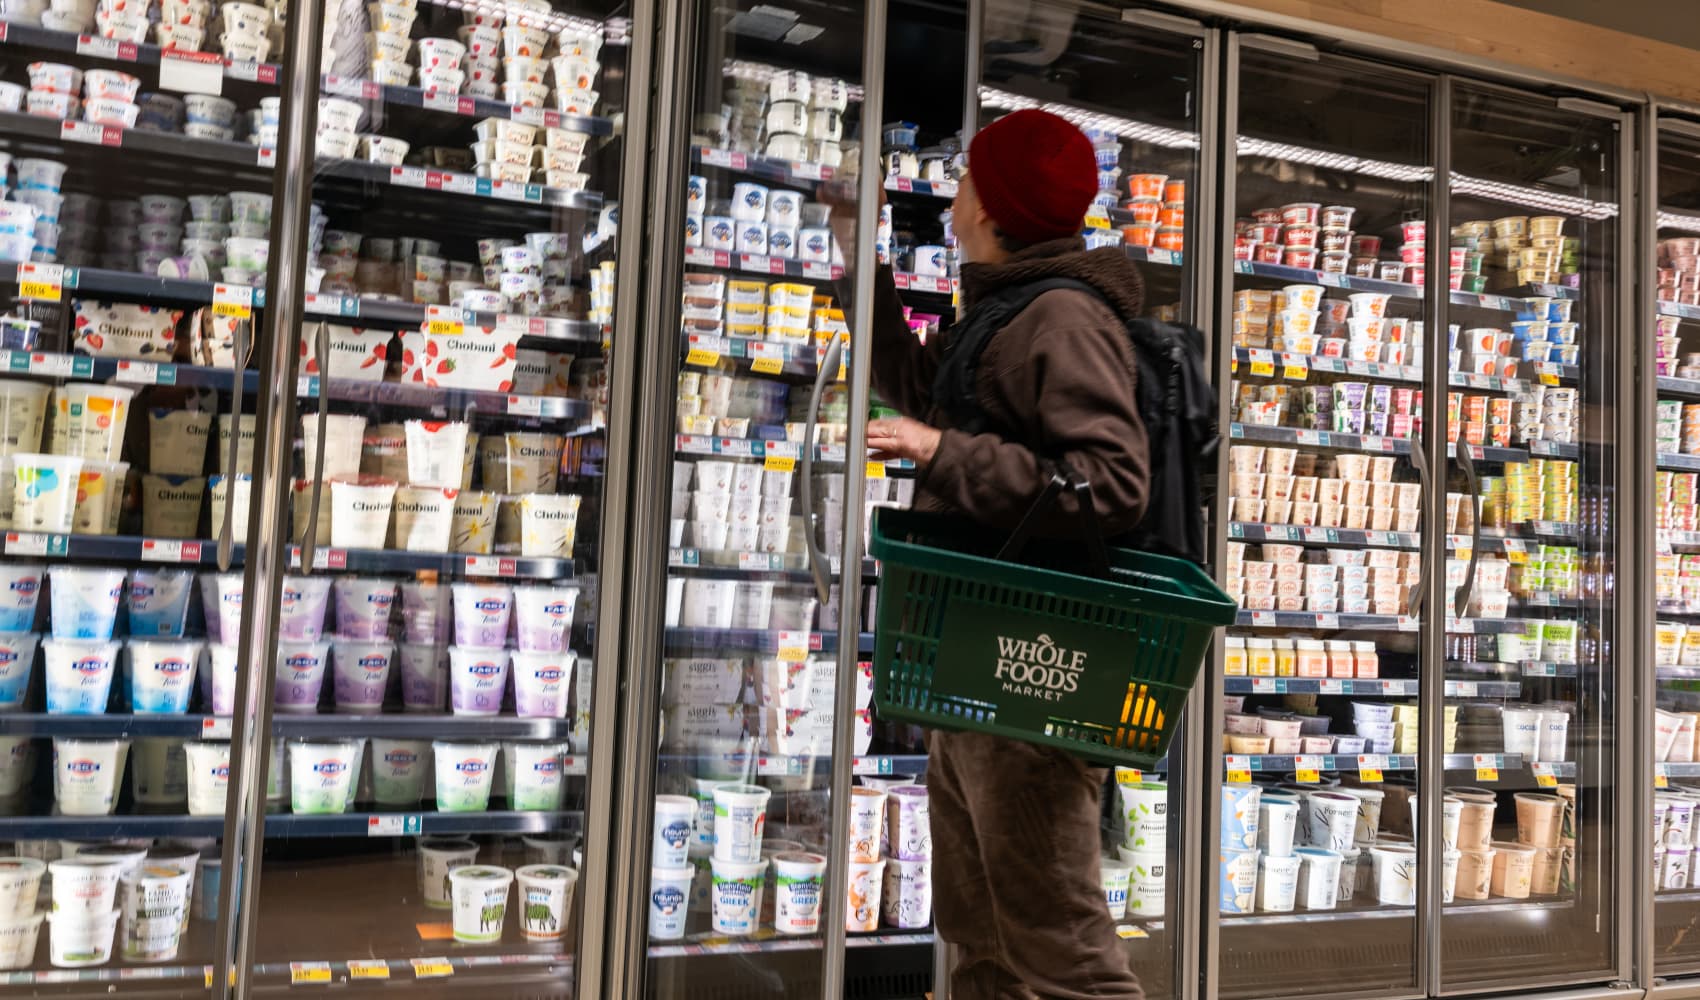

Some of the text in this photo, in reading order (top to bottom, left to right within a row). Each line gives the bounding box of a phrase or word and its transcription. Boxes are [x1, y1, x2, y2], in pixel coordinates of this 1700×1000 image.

[99, 322, 153, 339] Chobani
[447, 339, 496, 353] Chobani
[997, 634, 1088, 672] WHOLE
[994, 658, 1079, 693] FOODS
[1002, 682, 1063, 702] MARKET
